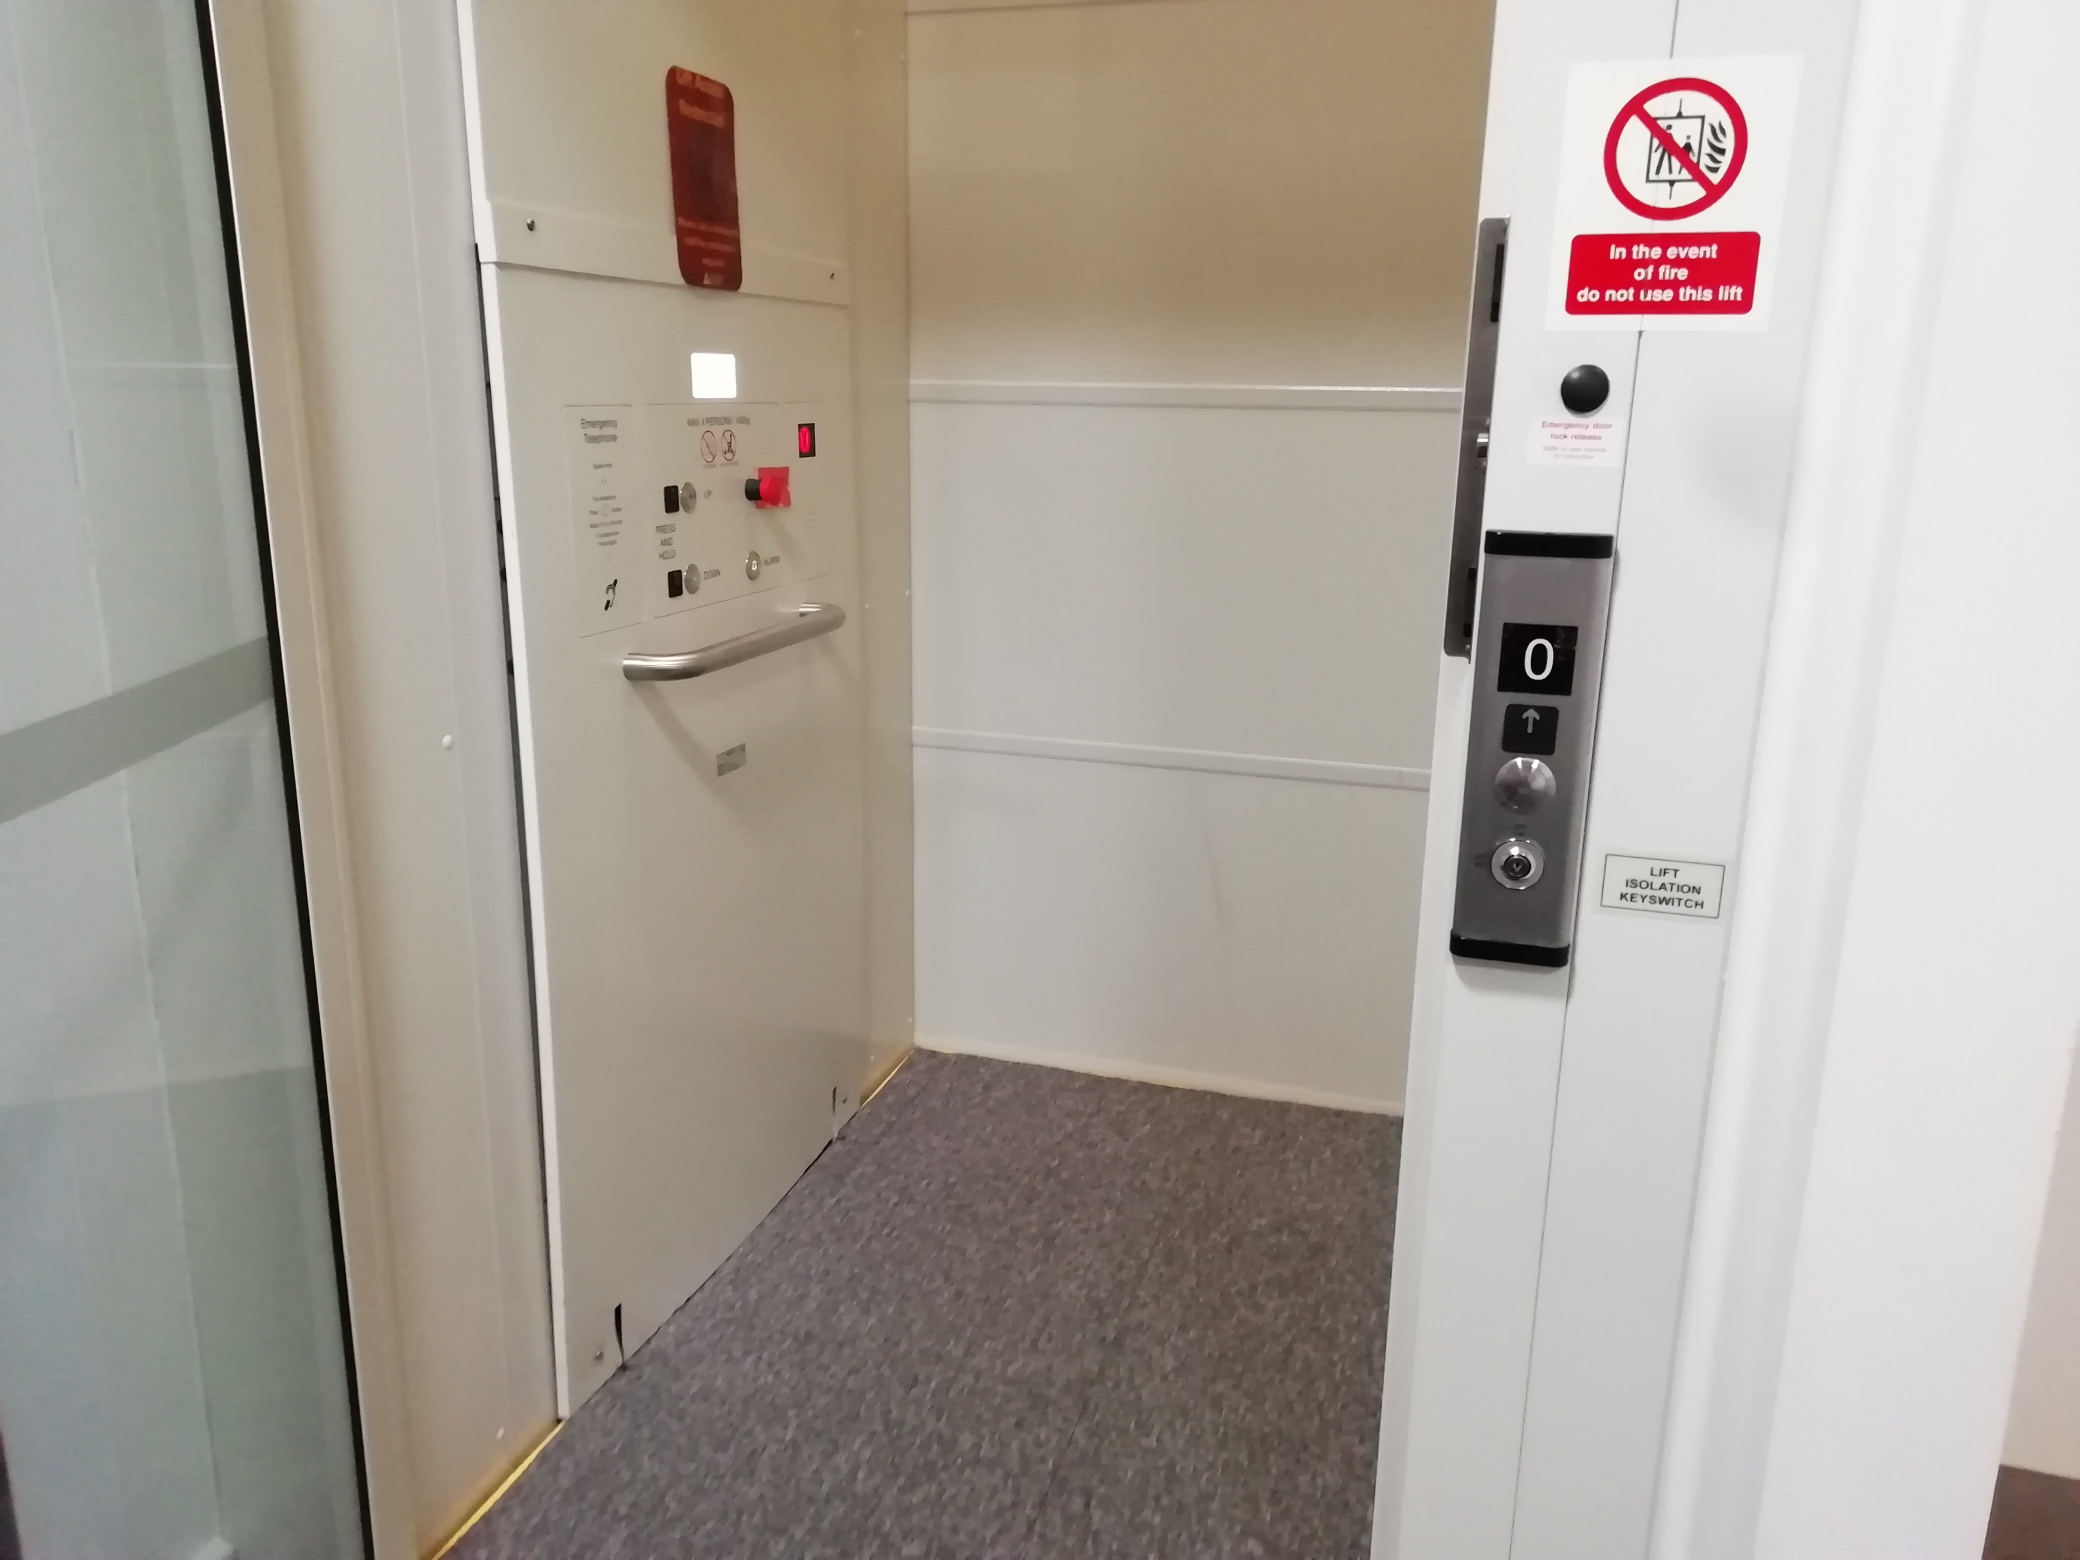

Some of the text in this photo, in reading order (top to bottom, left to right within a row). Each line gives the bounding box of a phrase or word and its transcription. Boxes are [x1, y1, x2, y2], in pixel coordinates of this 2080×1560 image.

[1609, 243, 1718, 259] In the event
[1633, 264, 1688, 281] of fire
[1576, 285, 1743, 302] do not use this lift
[1541, 420, 1590, 430] Emergency
[703, 569, 721, 580] DOWN
[1524, 638, 1554, 681] 0
[1650, 867, 1680, 878] LIFT
[1625, 878, 1702, 895] ISOLATION
[1619, 892, 1705, 909] KEYSWITCH
